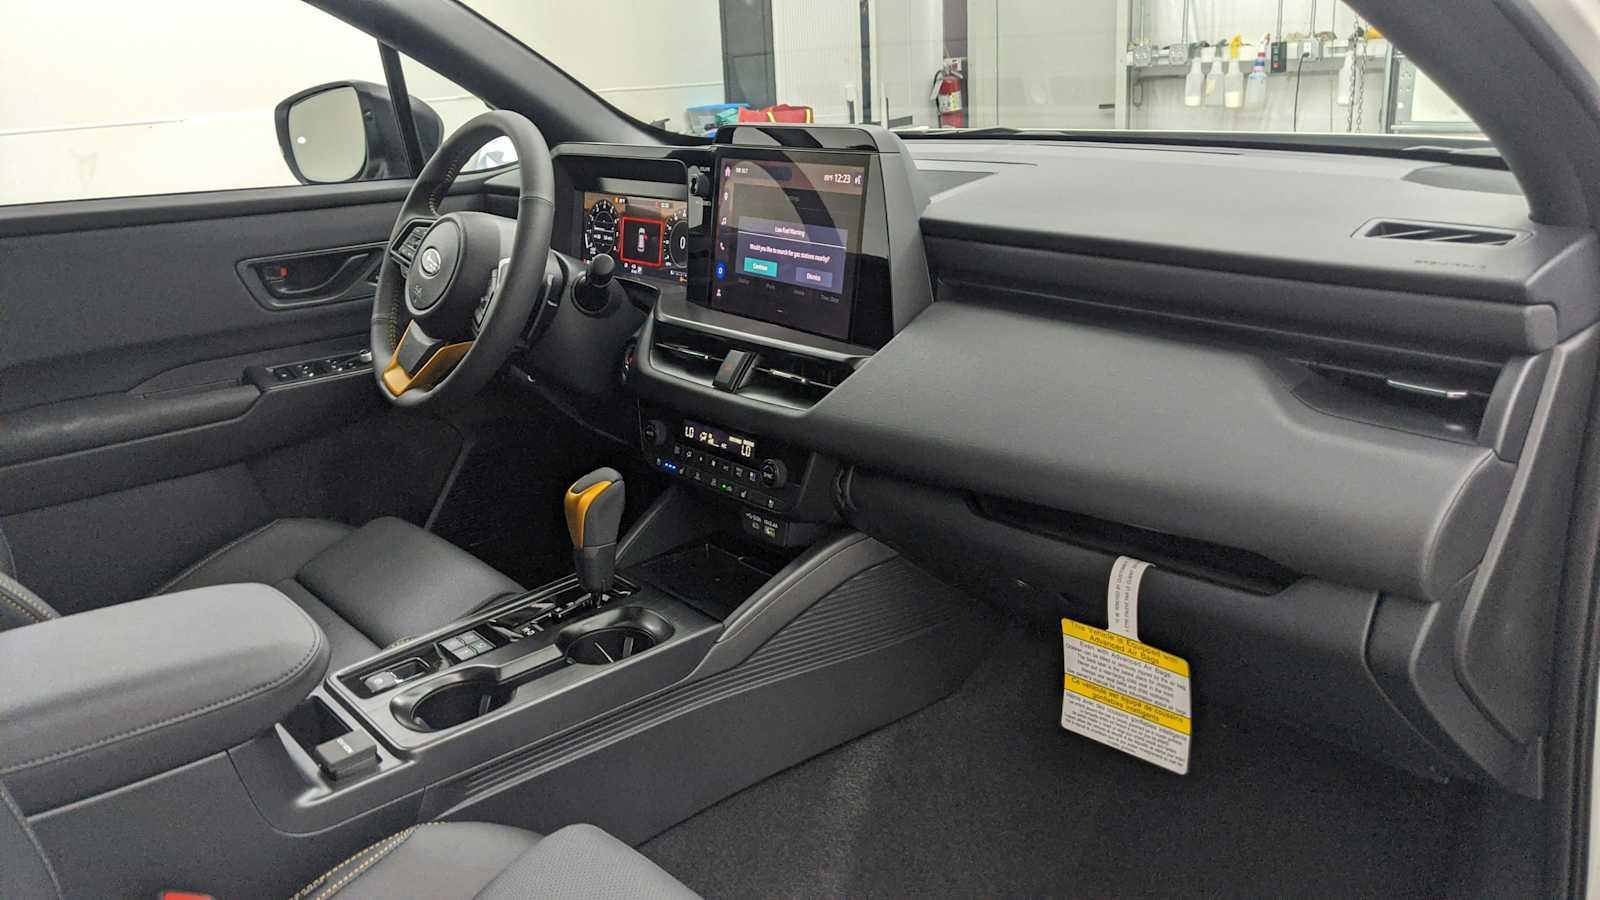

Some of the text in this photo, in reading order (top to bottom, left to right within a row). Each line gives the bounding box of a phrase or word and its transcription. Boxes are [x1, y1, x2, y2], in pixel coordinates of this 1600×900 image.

[834, 174, 851, 183] 12:23
[680, 236, 686, 249] 0
[685, 426, 694, 438] LO
[741, 445, 751, 457] LO
